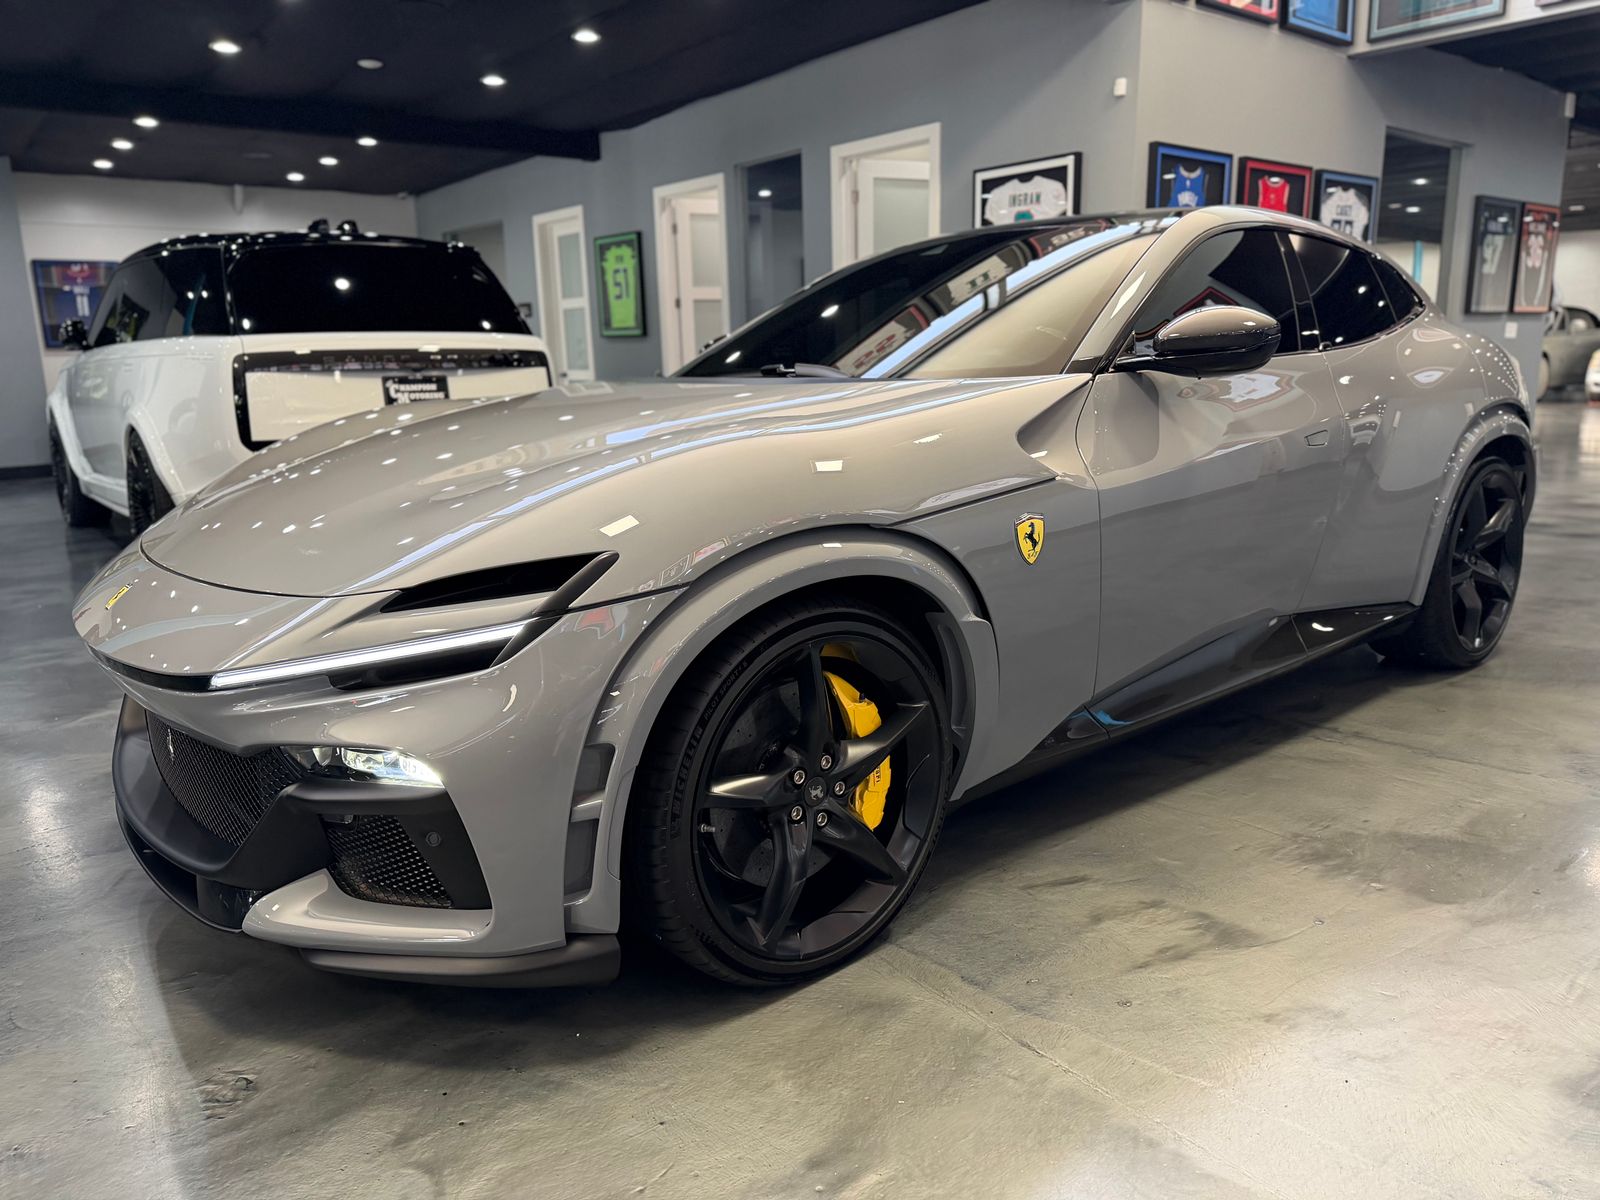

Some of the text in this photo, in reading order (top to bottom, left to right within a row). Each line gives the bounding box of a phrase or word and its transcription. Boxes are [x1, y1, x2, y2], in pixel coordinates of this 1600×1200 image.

[1008, 192, 1041, 207] INGRAM
[612, 266, 630, 300] 51
[388, 382, 437, 399] CHAMPION
[397, 391, 445, 404] MOTORING
[672, 727, 703, 816] MICHELIN
[703, 696, 720, 721] PILOT
[719, 670, 739, 695] SPORT
